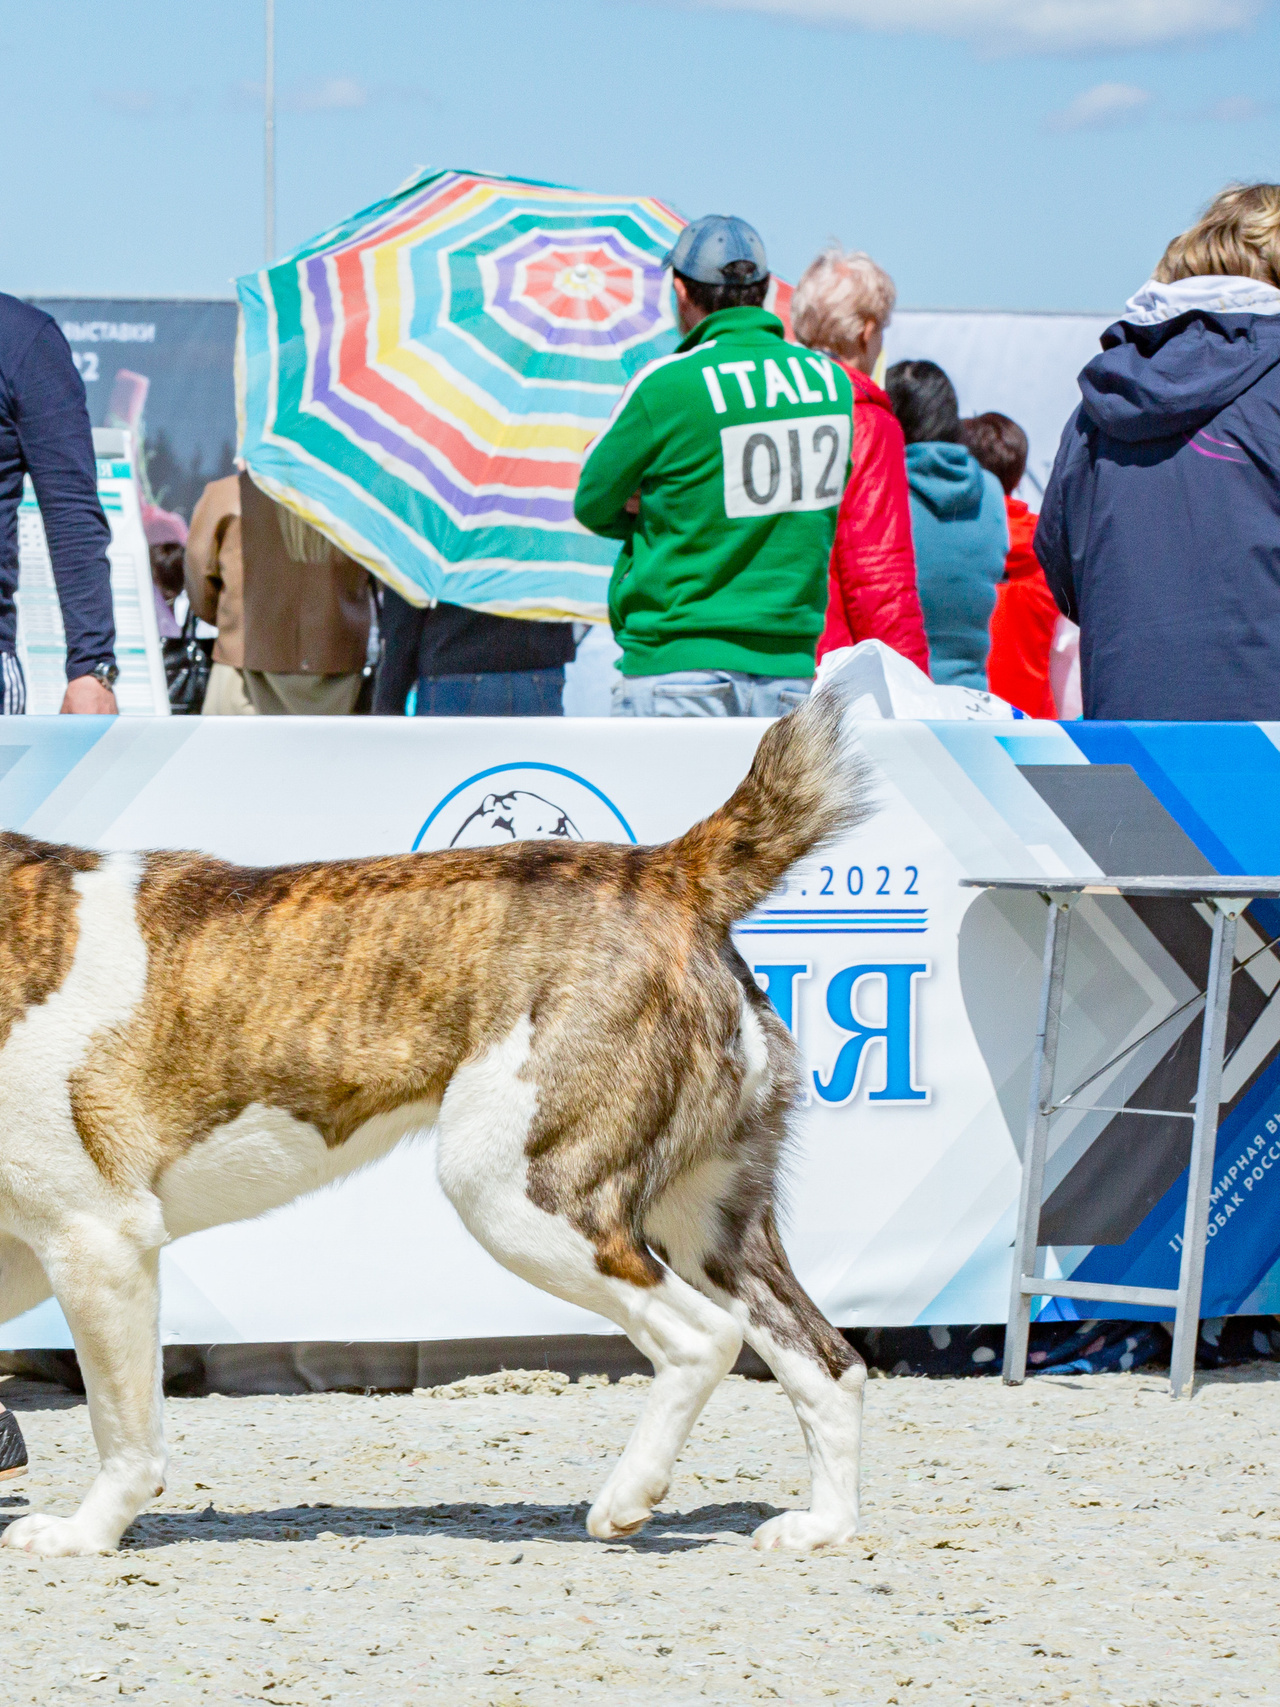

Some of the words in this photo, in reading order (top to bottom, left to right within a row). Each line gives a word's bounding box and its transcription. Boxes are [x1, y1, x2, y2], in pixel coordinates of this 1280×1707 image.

[702, 357, 838, 414] ITALY
[742, 425, 839, 505] 012
[778, 865, 919, 897] .2022
[1209, 1135, 1266, 1212] МИРНАЯ
[1205, 1192, 1245, 1246] ОБАК
